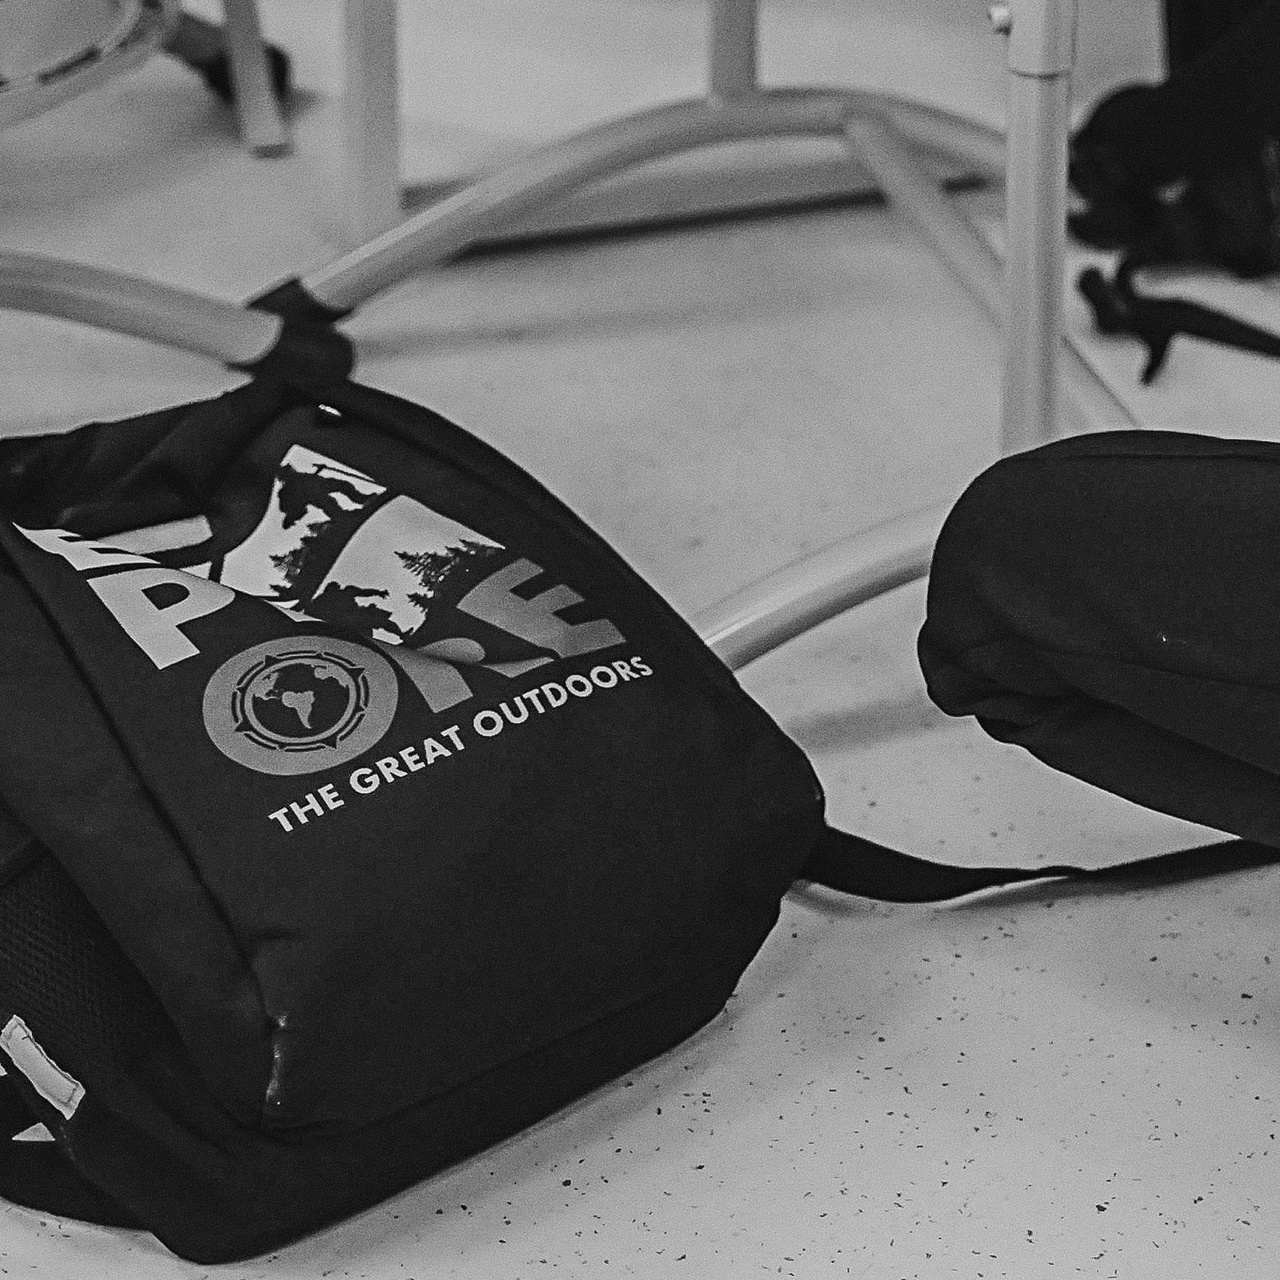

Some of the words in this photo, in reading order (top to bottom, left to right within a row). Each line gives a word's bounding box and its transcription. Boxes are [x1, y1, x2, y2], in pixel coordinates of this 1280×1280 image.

[267, 783, 345, 833] THE
[349, 724, 465, 795] GREAT
[472, 655, 654, 738] OUTDOORS
